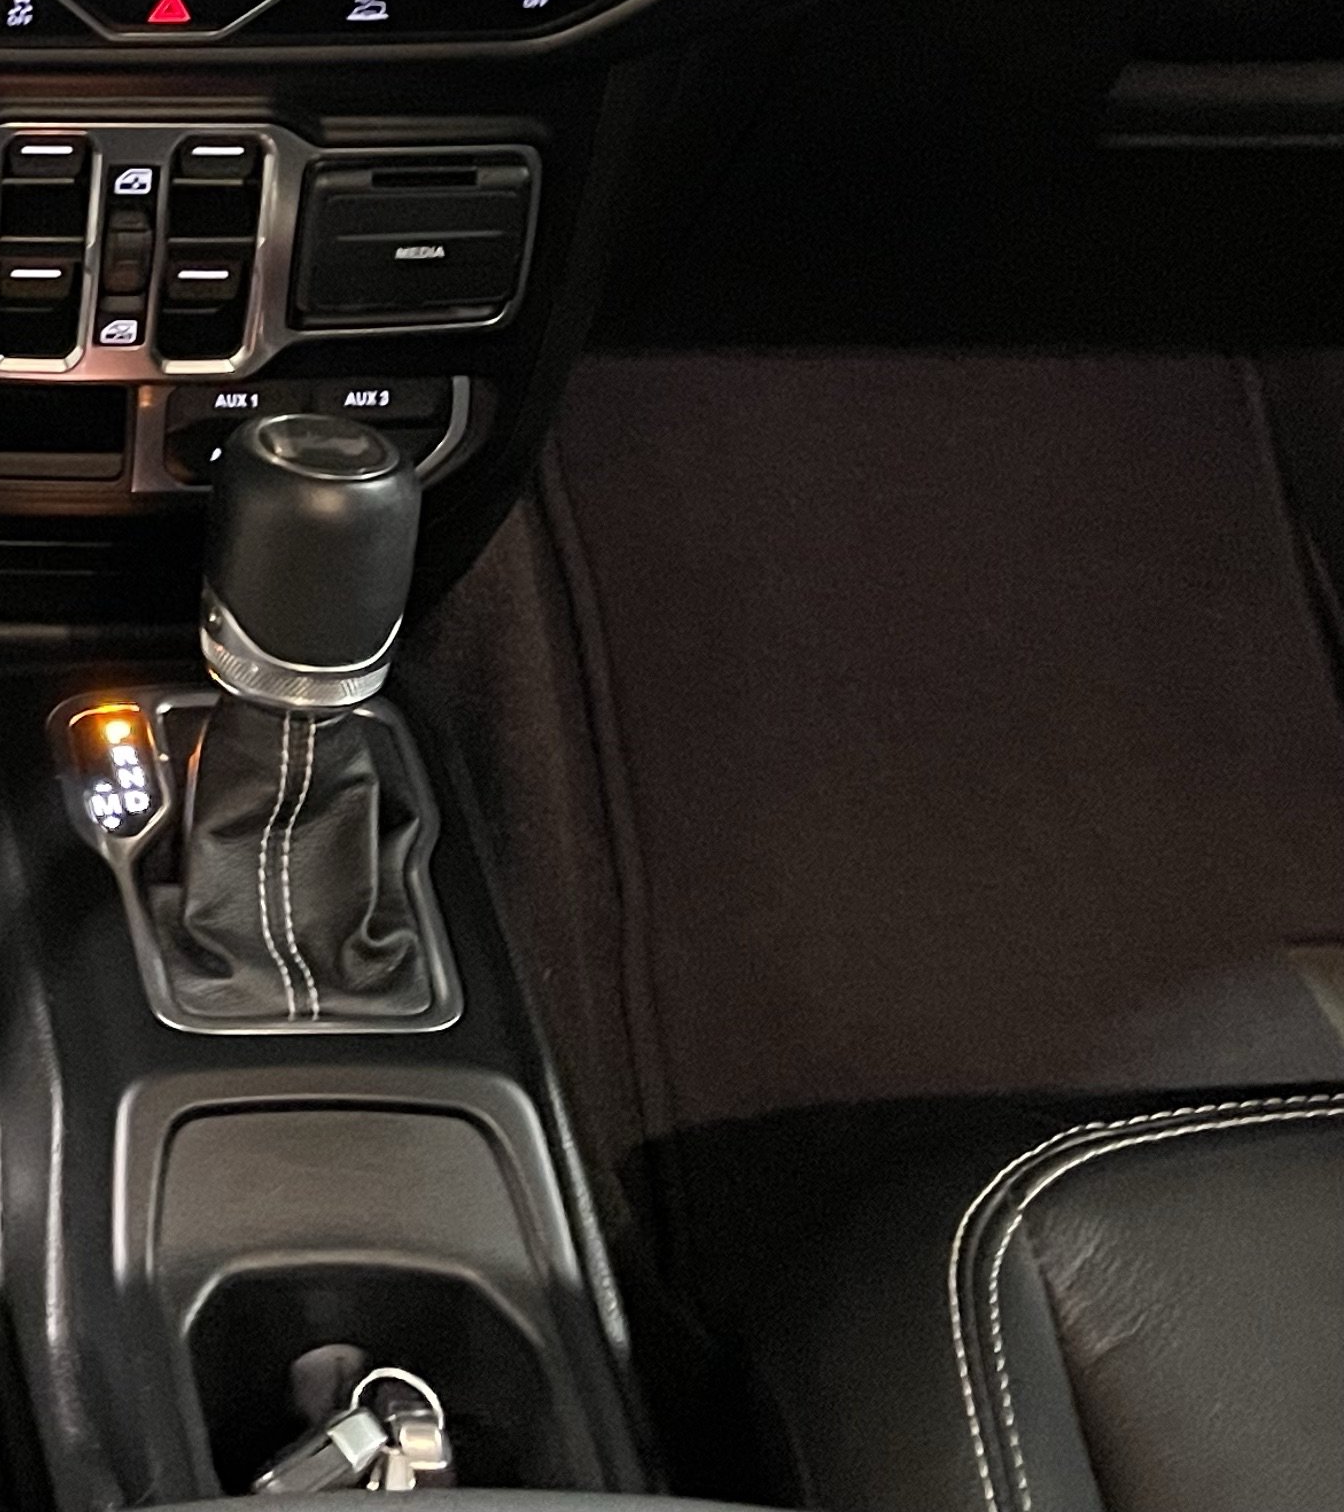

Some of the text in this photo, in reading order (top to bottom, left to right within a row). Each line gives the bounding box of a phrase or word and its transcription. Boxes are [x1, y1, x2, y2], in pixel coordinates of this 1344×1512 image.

[394, 245, 446, 259] MEDIA
[214, 392, 259, 408] AUX 1
[344, 391, 377, 407] AUX
